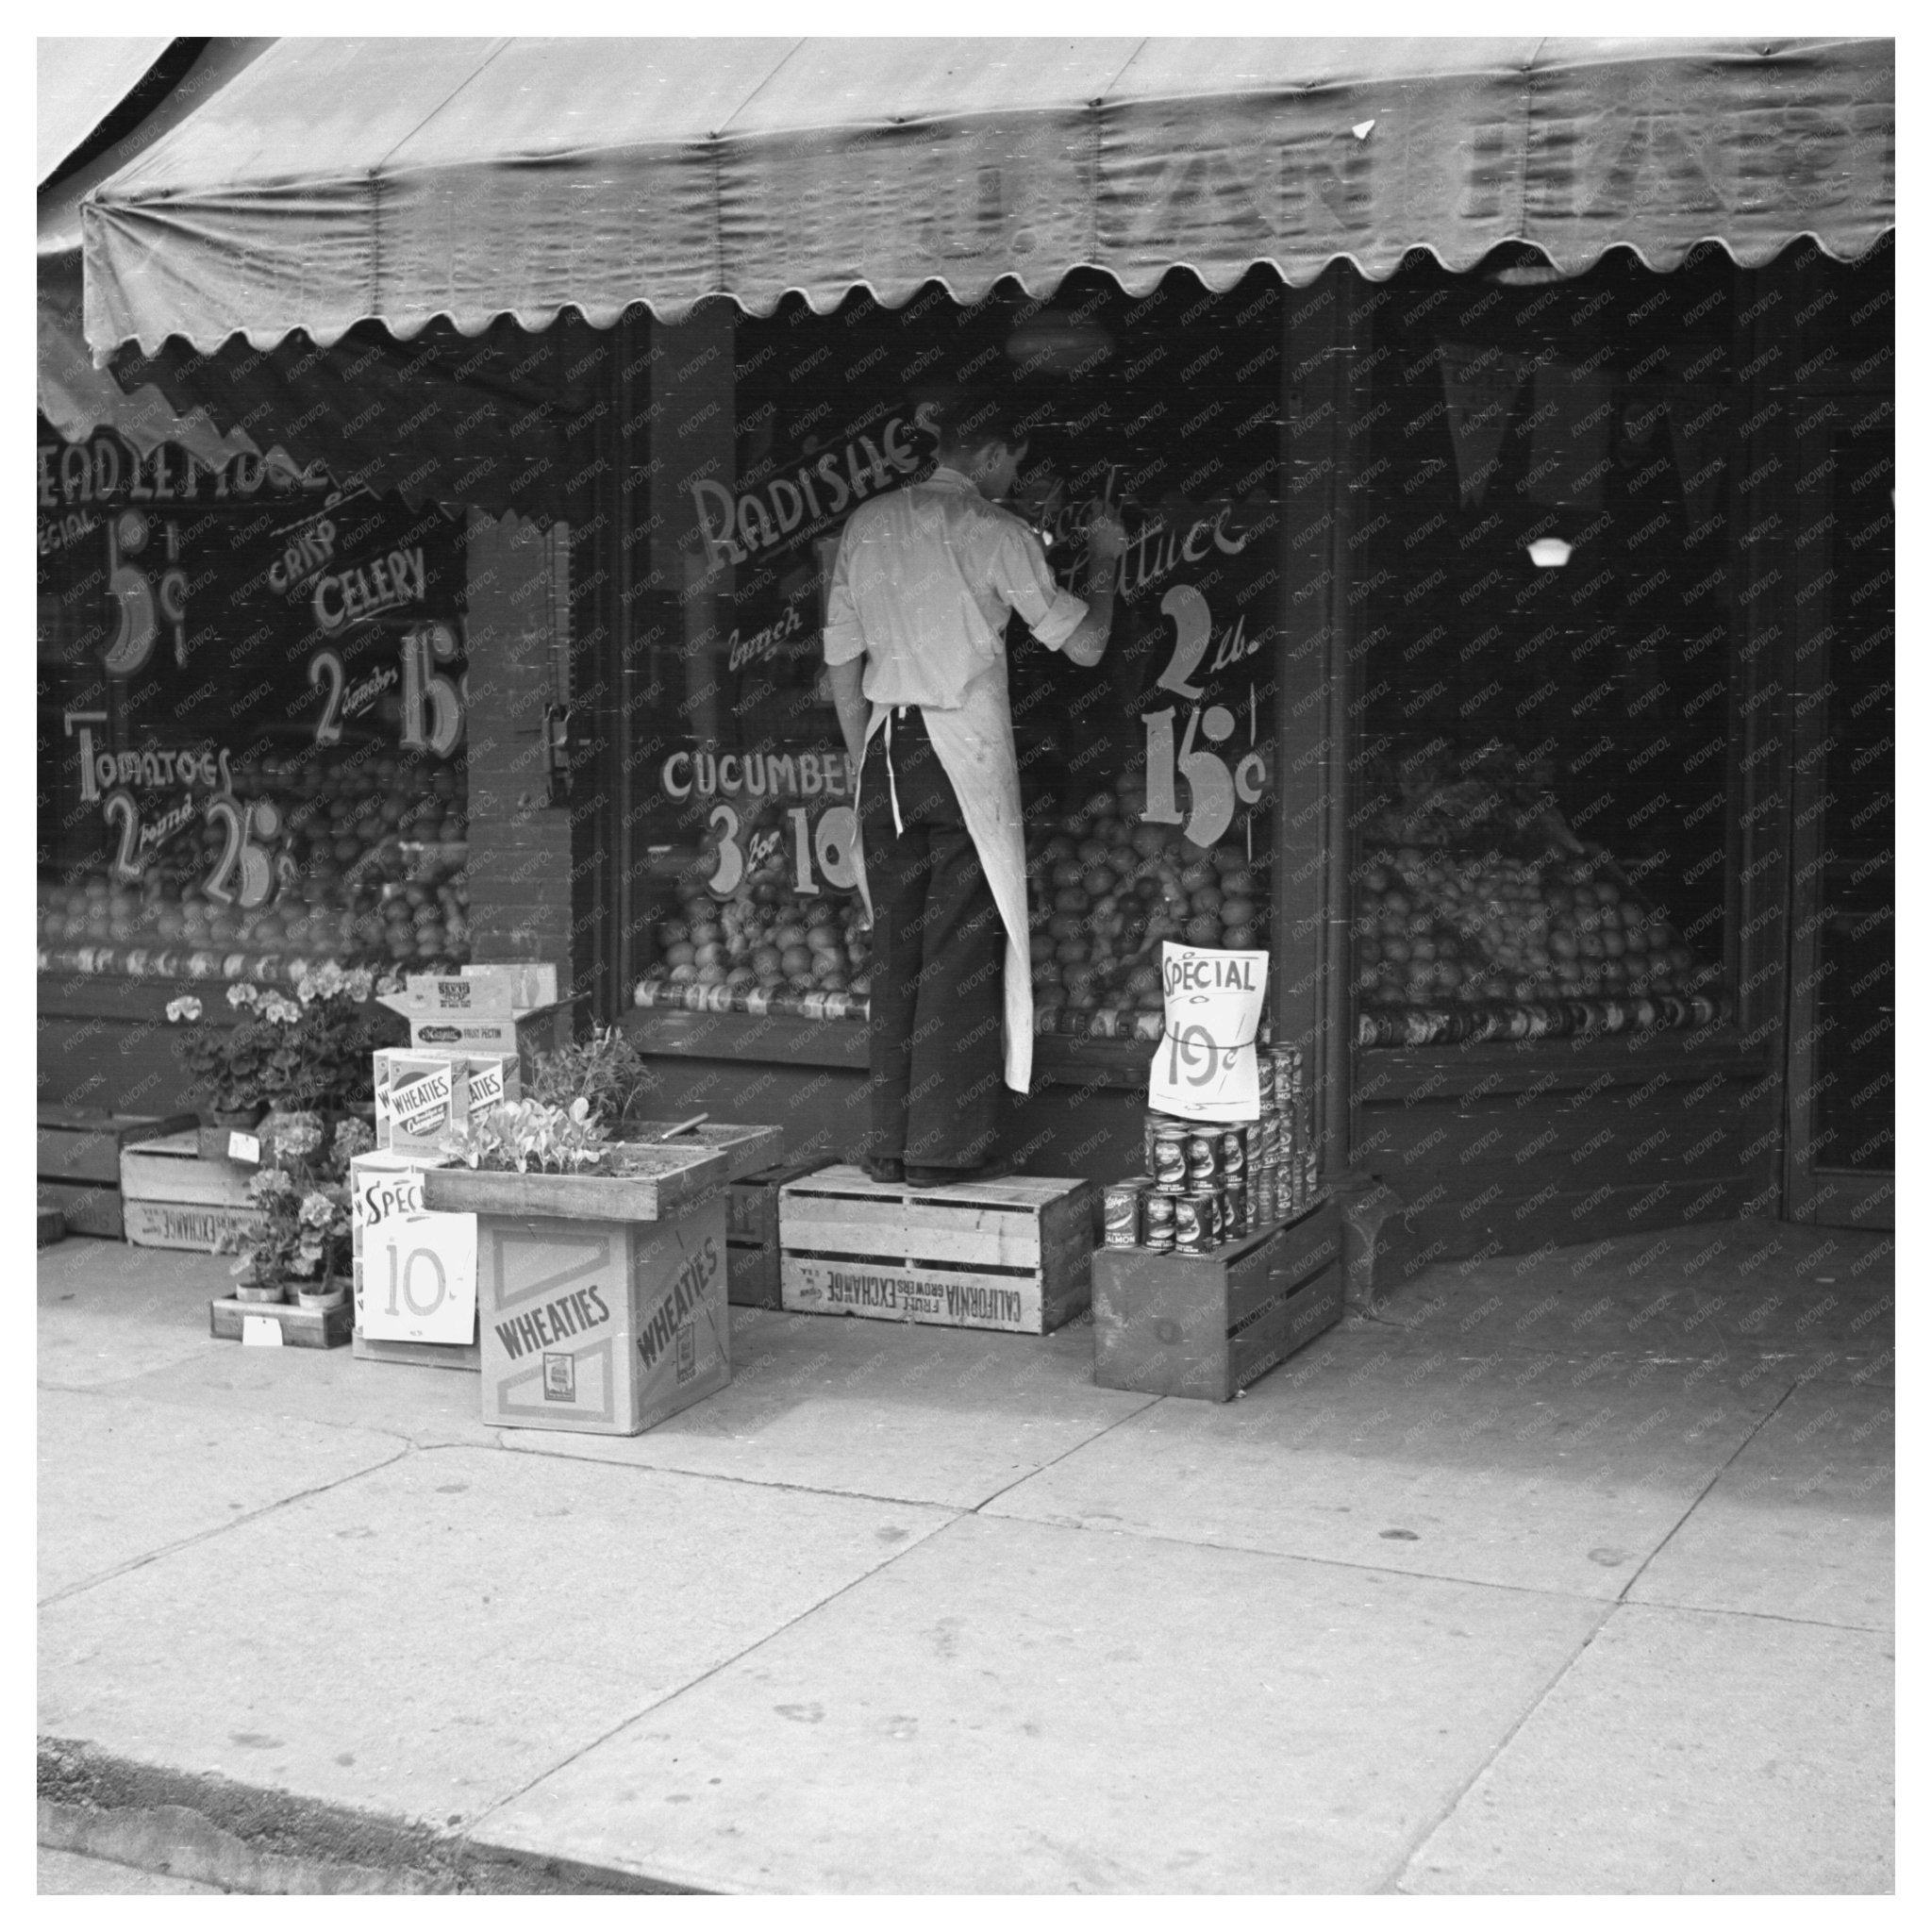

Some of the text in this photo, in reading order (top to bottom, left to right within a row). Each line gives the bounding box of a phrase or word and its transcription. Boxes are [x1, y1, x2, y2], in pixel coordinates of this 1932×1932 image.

[691, 402, 941, 572] RADISHES
[269, 520, 337, 591] CRISP
[314, 547, 425, 628] CELERY
[1157, 584, 1211, 699] 2
[310, 651, 343, 741] 2
[65, 711, 231, 802] TOMATOES
[104, 793, 141, 875] 2
[708, 805, 743, 894] 3
[1164, 956, 1257, 997] SPECIAL
[391, 1075, 449, 1115] WHEATIES
[494, 1285, 610, 1361] WHEATIES
[636, 1236, 718, 1372] WHEATIES
[827, 1271, 1021, 1323] CALIFORNIA FRUIT GROWERS EXCHANGE
